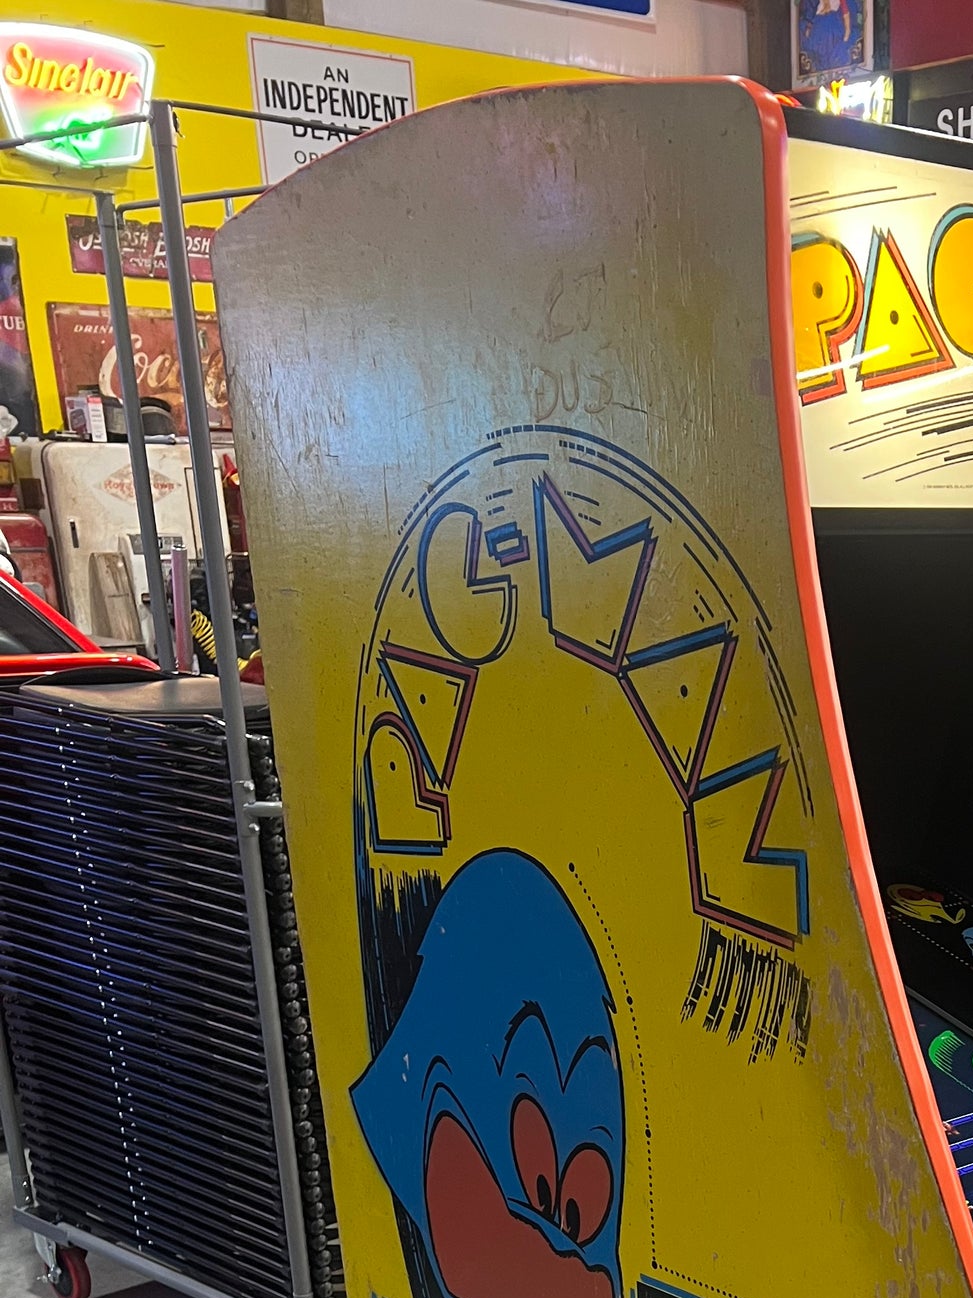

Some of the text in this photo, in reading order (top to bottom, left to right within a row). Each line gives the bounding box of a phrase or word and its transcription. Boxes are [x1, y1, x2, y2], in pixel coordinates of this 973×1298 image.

[5, 42, 139, 100] Sinclair
[324, 66, 349, 83] AN
[263, 78, 409, 122] INDEPENDENT
